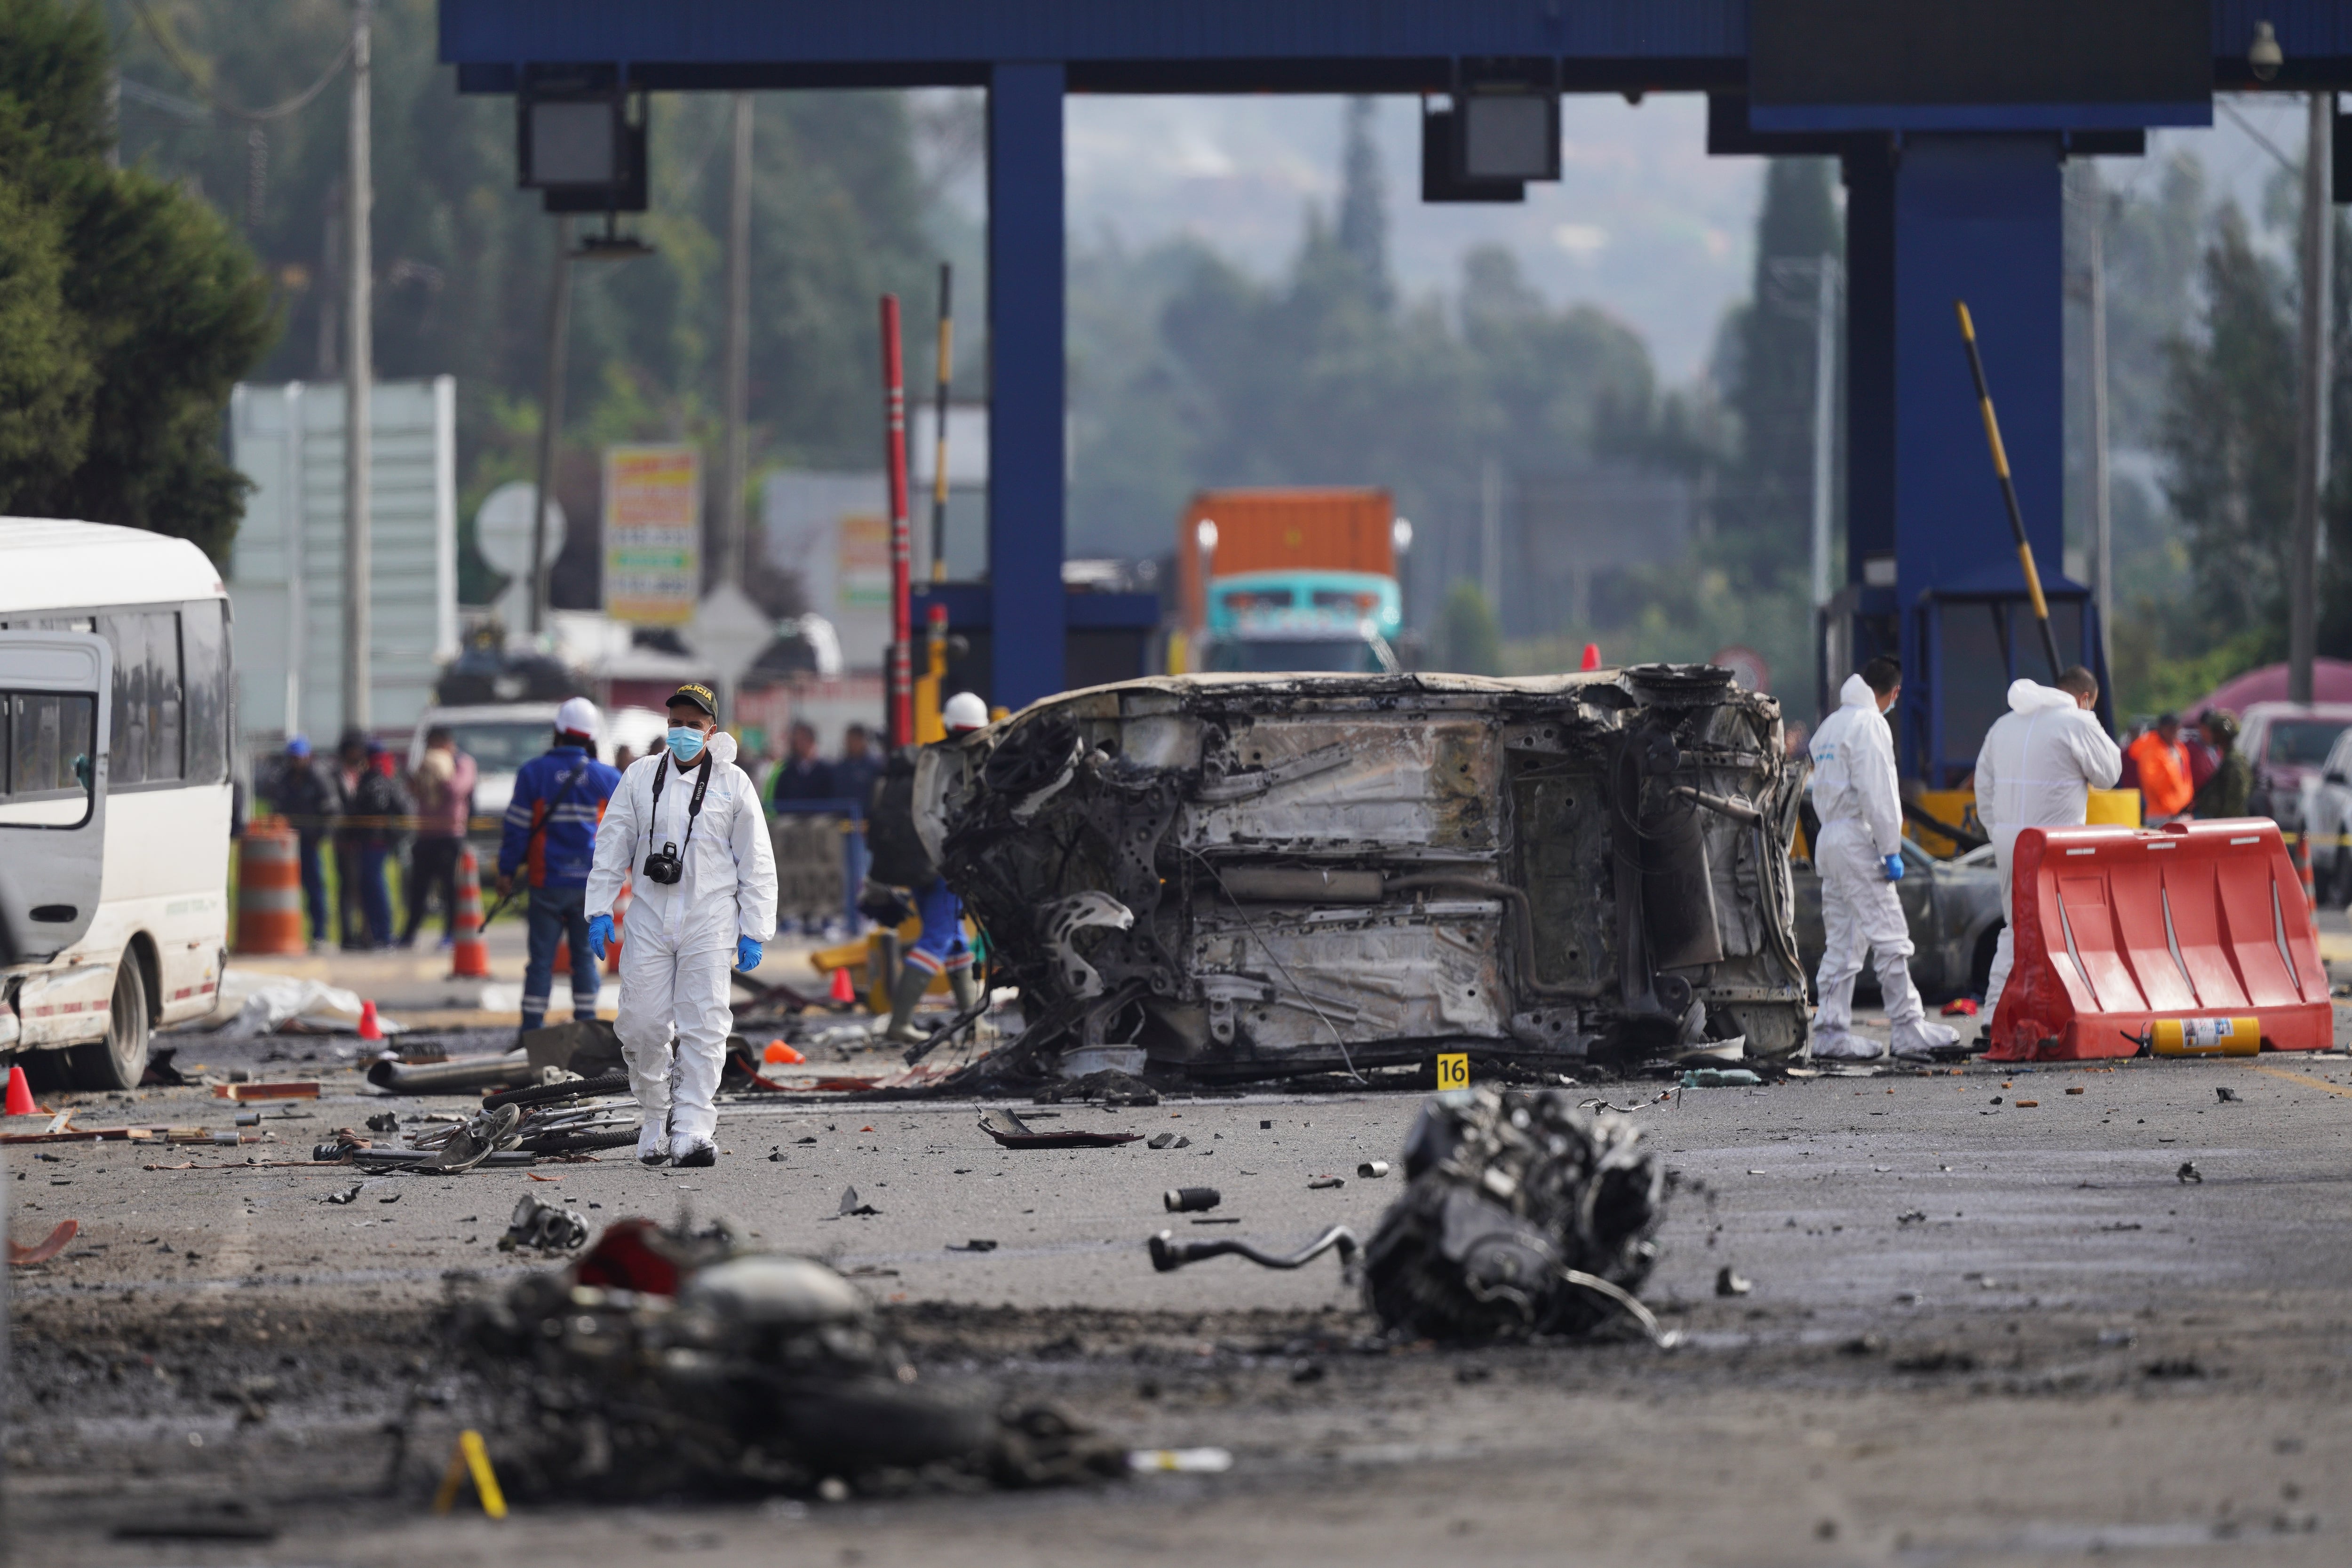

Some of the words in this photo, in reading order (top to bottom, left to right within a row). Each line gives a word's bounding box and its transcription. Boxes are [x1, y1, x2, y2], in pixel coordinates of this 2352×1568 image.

[676, 685, 712, 701] POLICIA
[695, 781, 705, 800] Canon
[1440, 1059, 1465, 1082] 16
